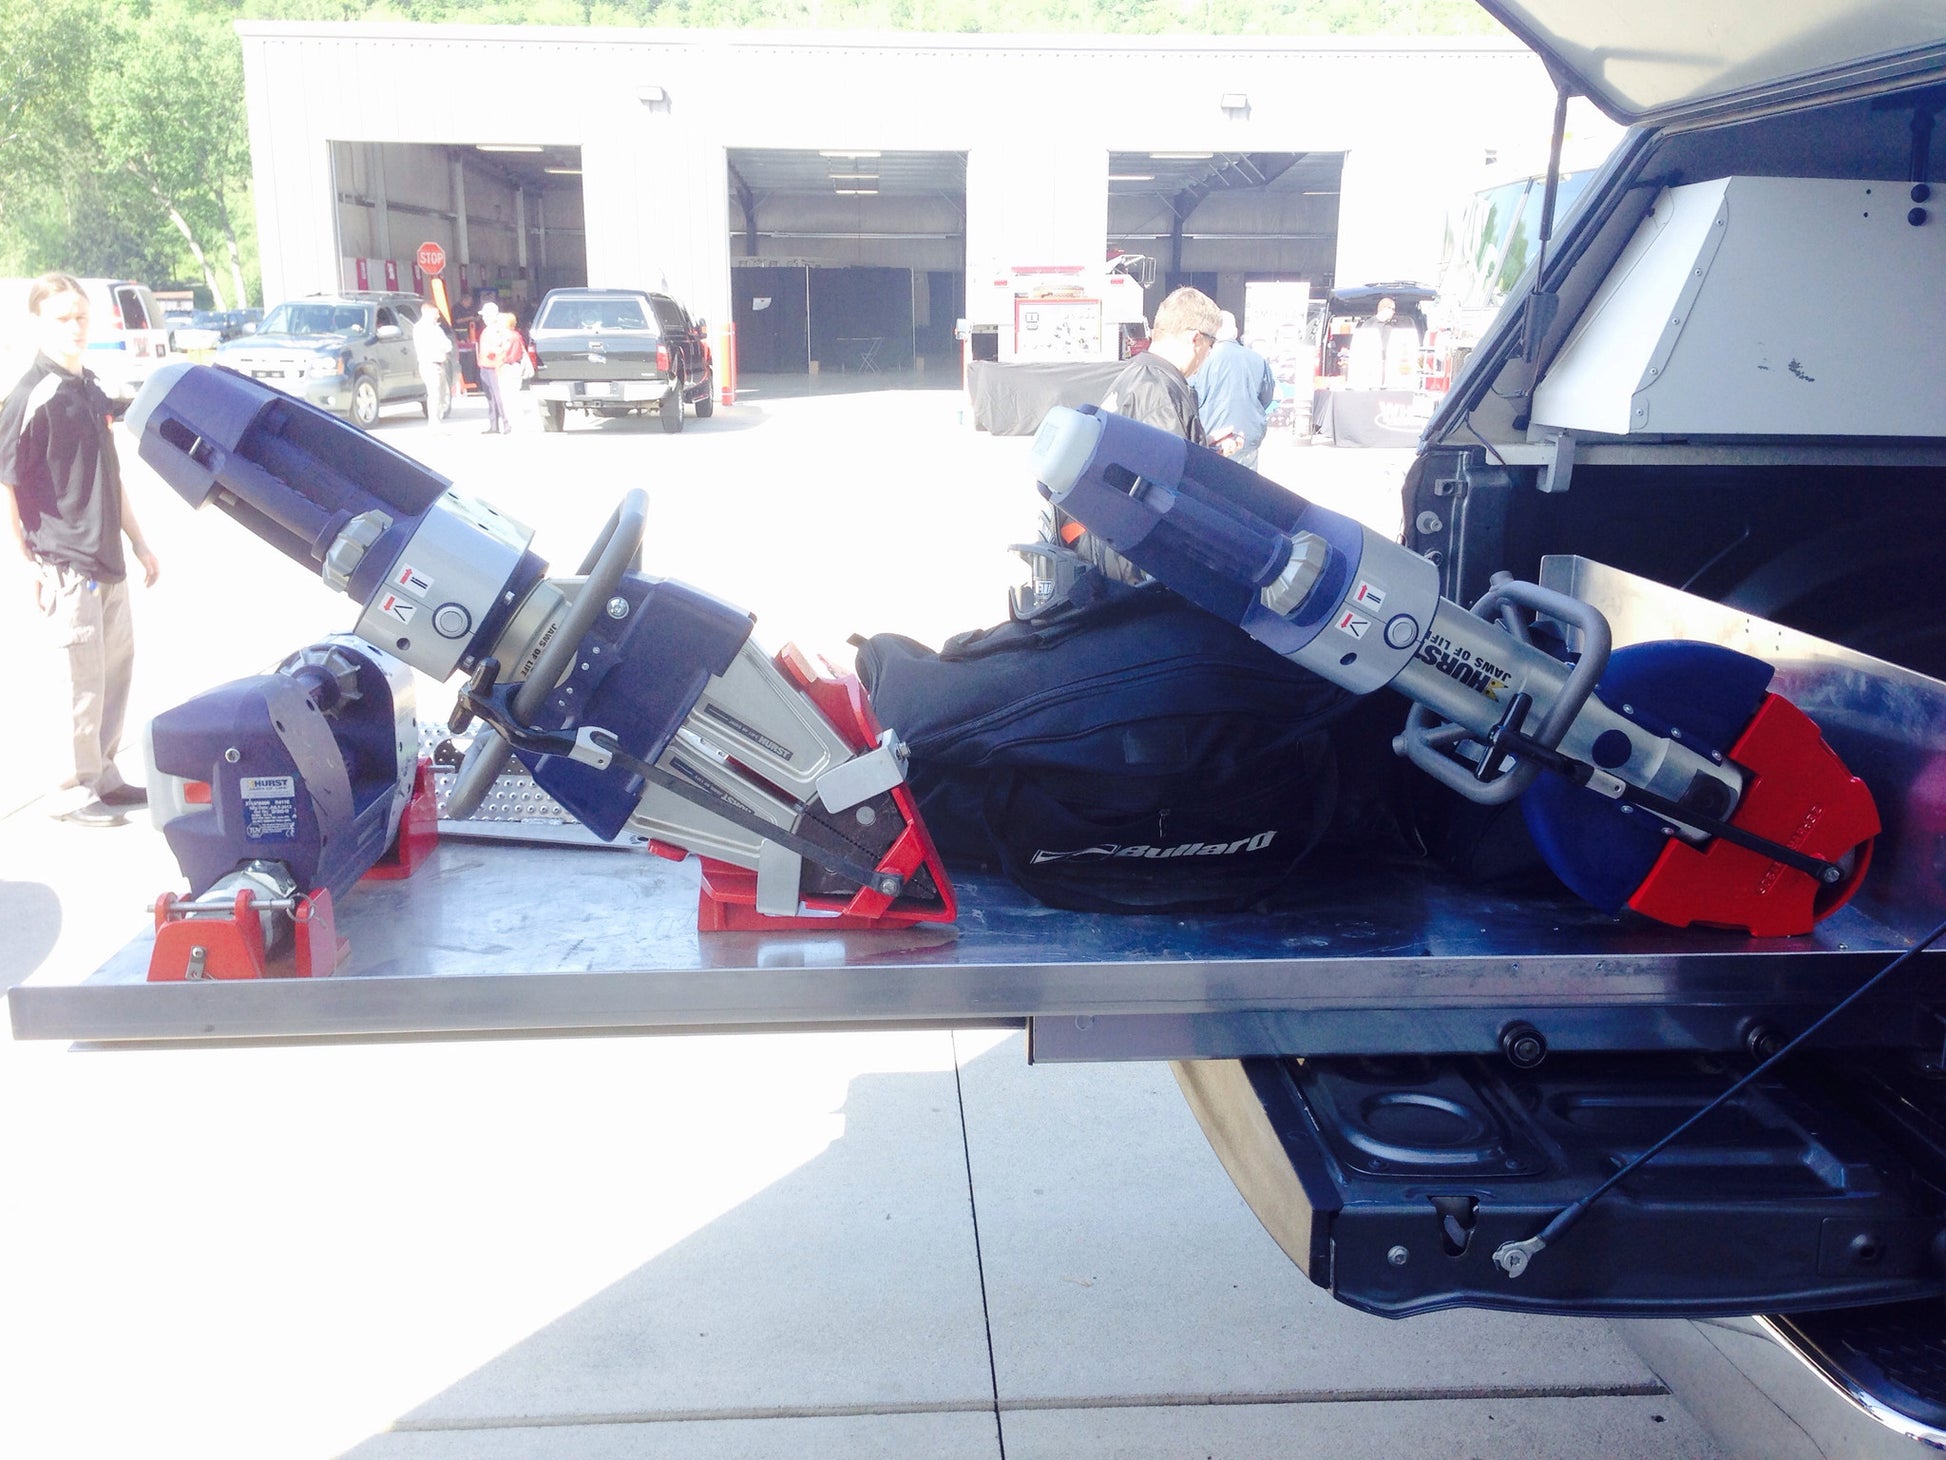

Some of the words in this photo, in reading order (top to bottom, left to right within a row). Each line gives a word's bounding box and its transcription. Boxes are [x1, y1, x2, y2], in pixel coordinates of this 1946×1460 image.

[420, 252, 443, 264] STOP
[540, 623, 557, 647] JAWS
[531, 648, 541, 660] OF
[1453, 647, 1471, 661] OF
[520, 660, 533, 677] LIFE
[1474, 657, 1512, 682] JAWS
[758, 736, 790, 757] HURST
[254, 779, 288, 787] HURST
[1114, 830, 1277, 859] Bullard
